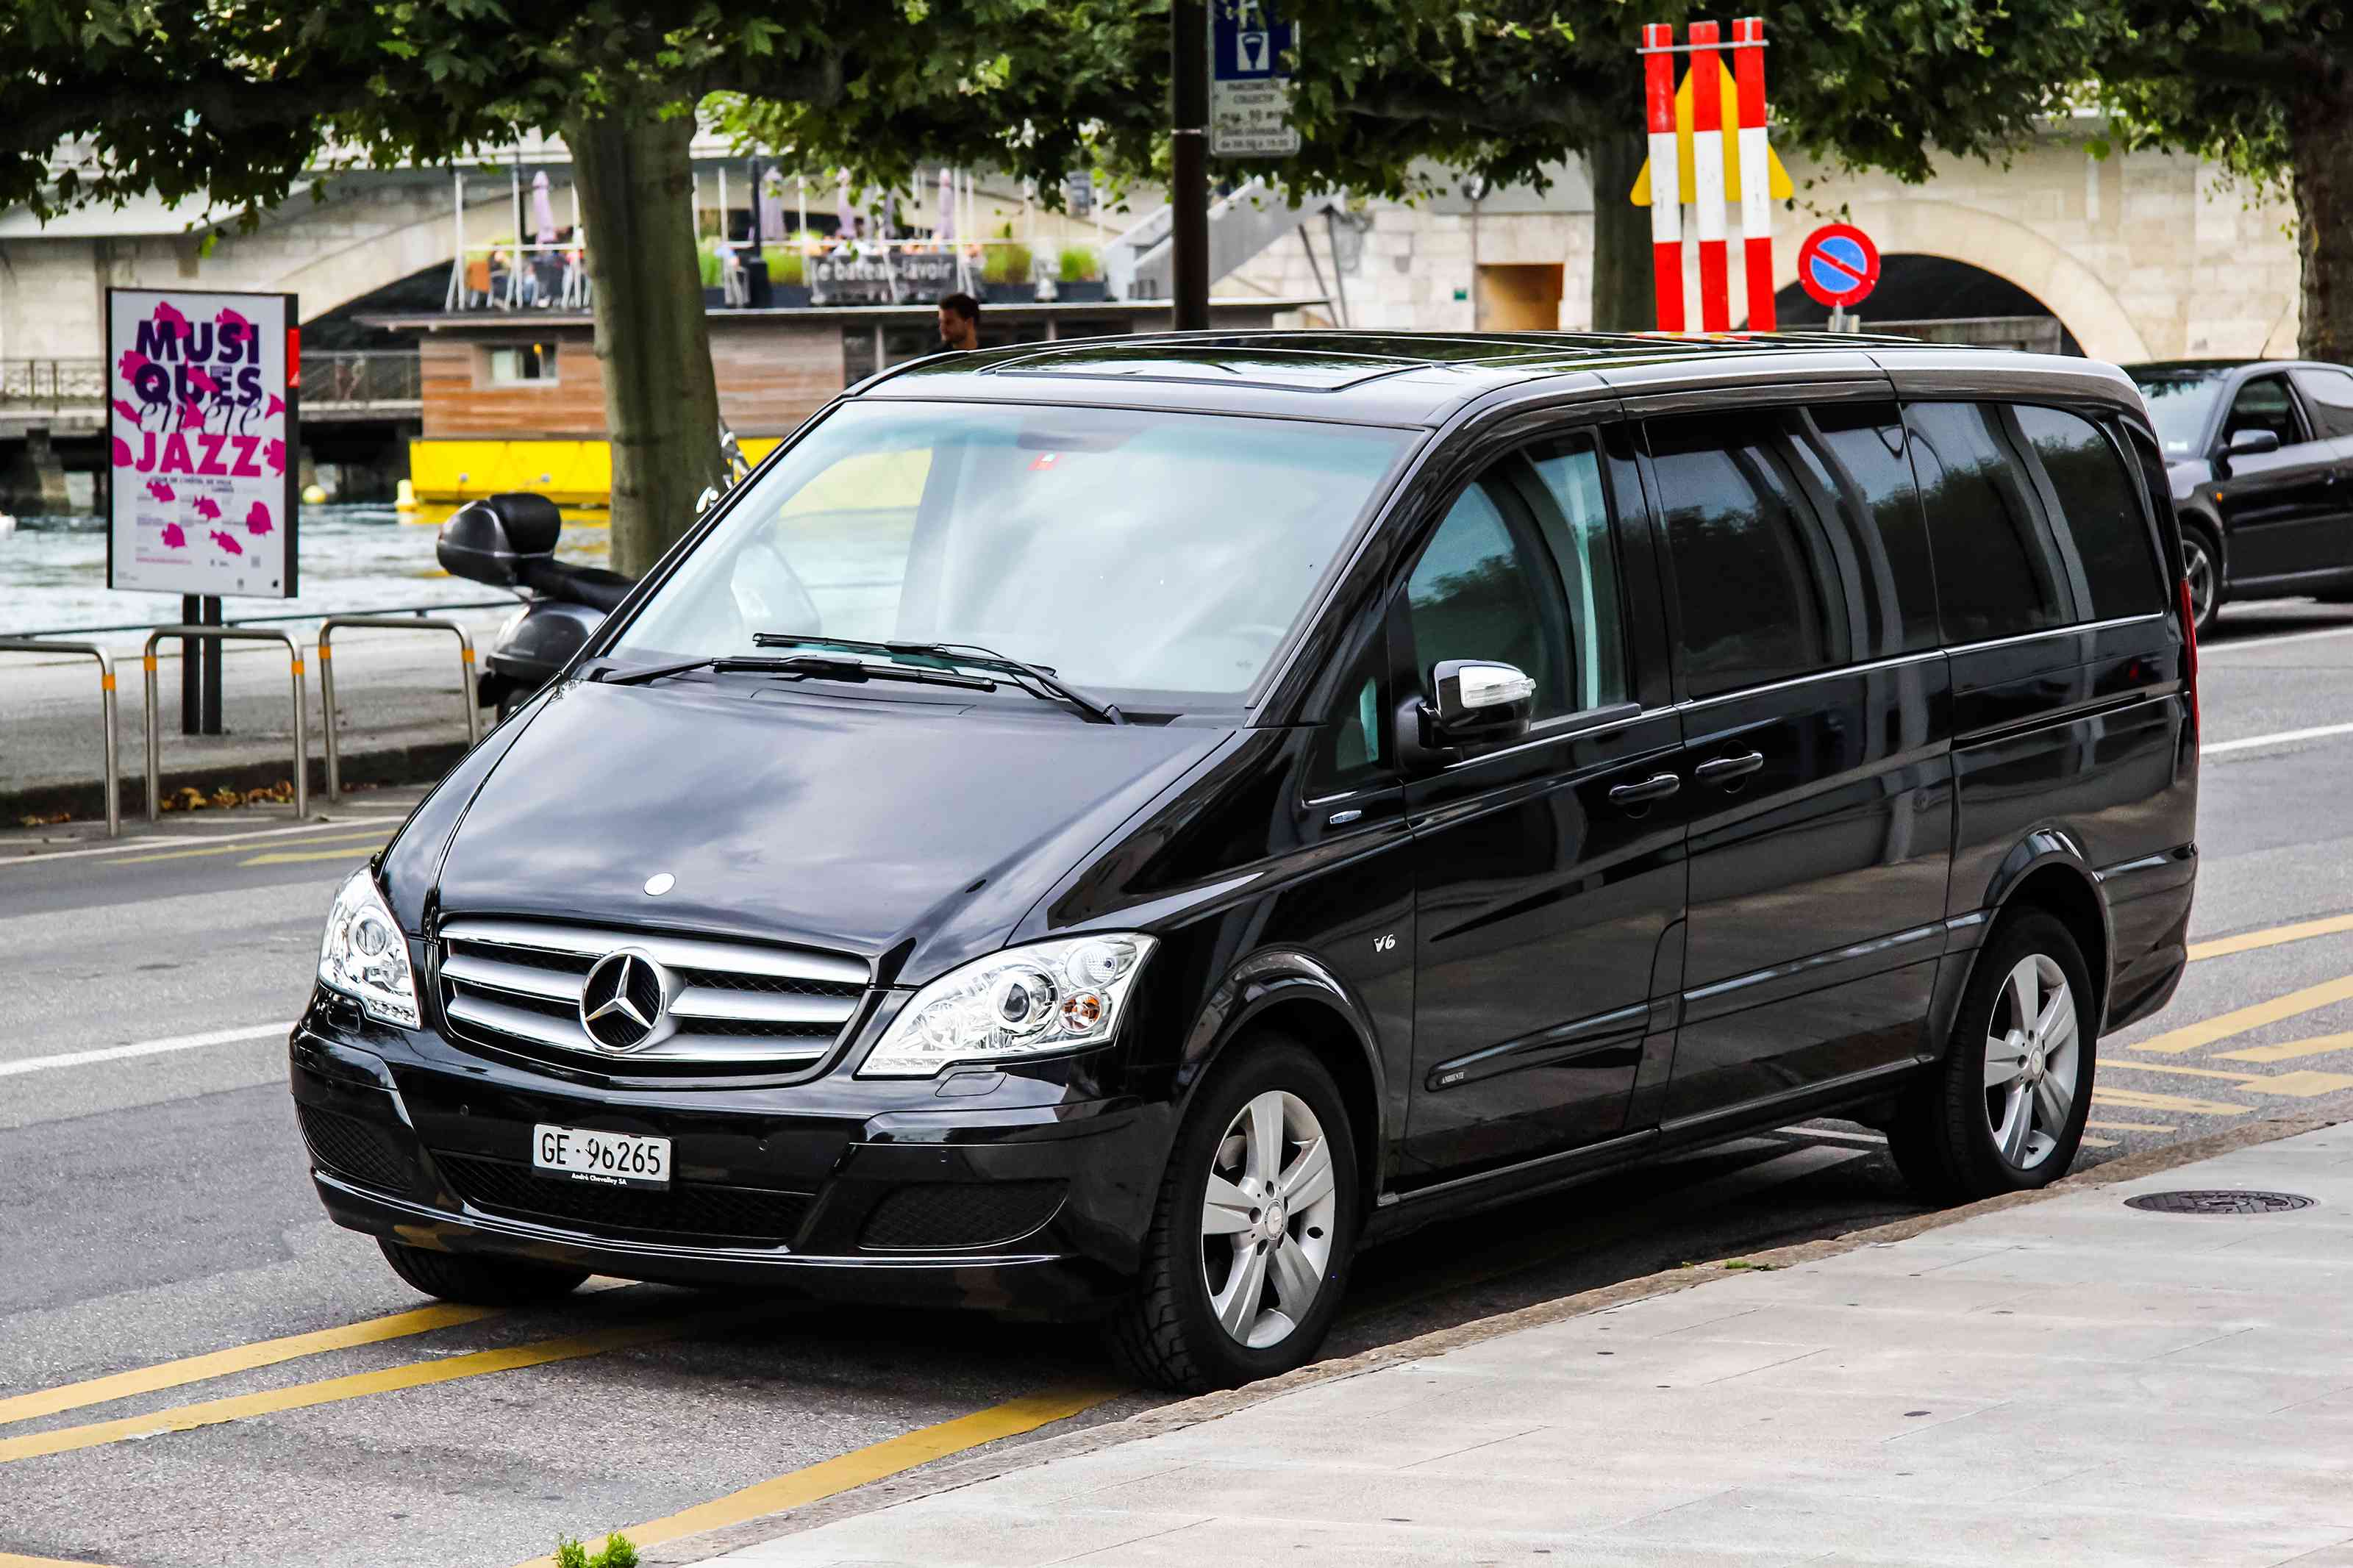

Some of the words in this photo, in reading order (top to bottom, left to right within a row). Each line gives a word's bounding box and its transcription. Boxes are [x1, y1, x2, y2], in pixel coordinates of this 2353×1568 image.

[136, 321, 260, 364] MUSI
[135, 363, 263, 407] QUES
[135, 432, 261, 476] JAZZ
[1374, 934, 1396, 953] V6
[571, 1173, 588, 1181] André
